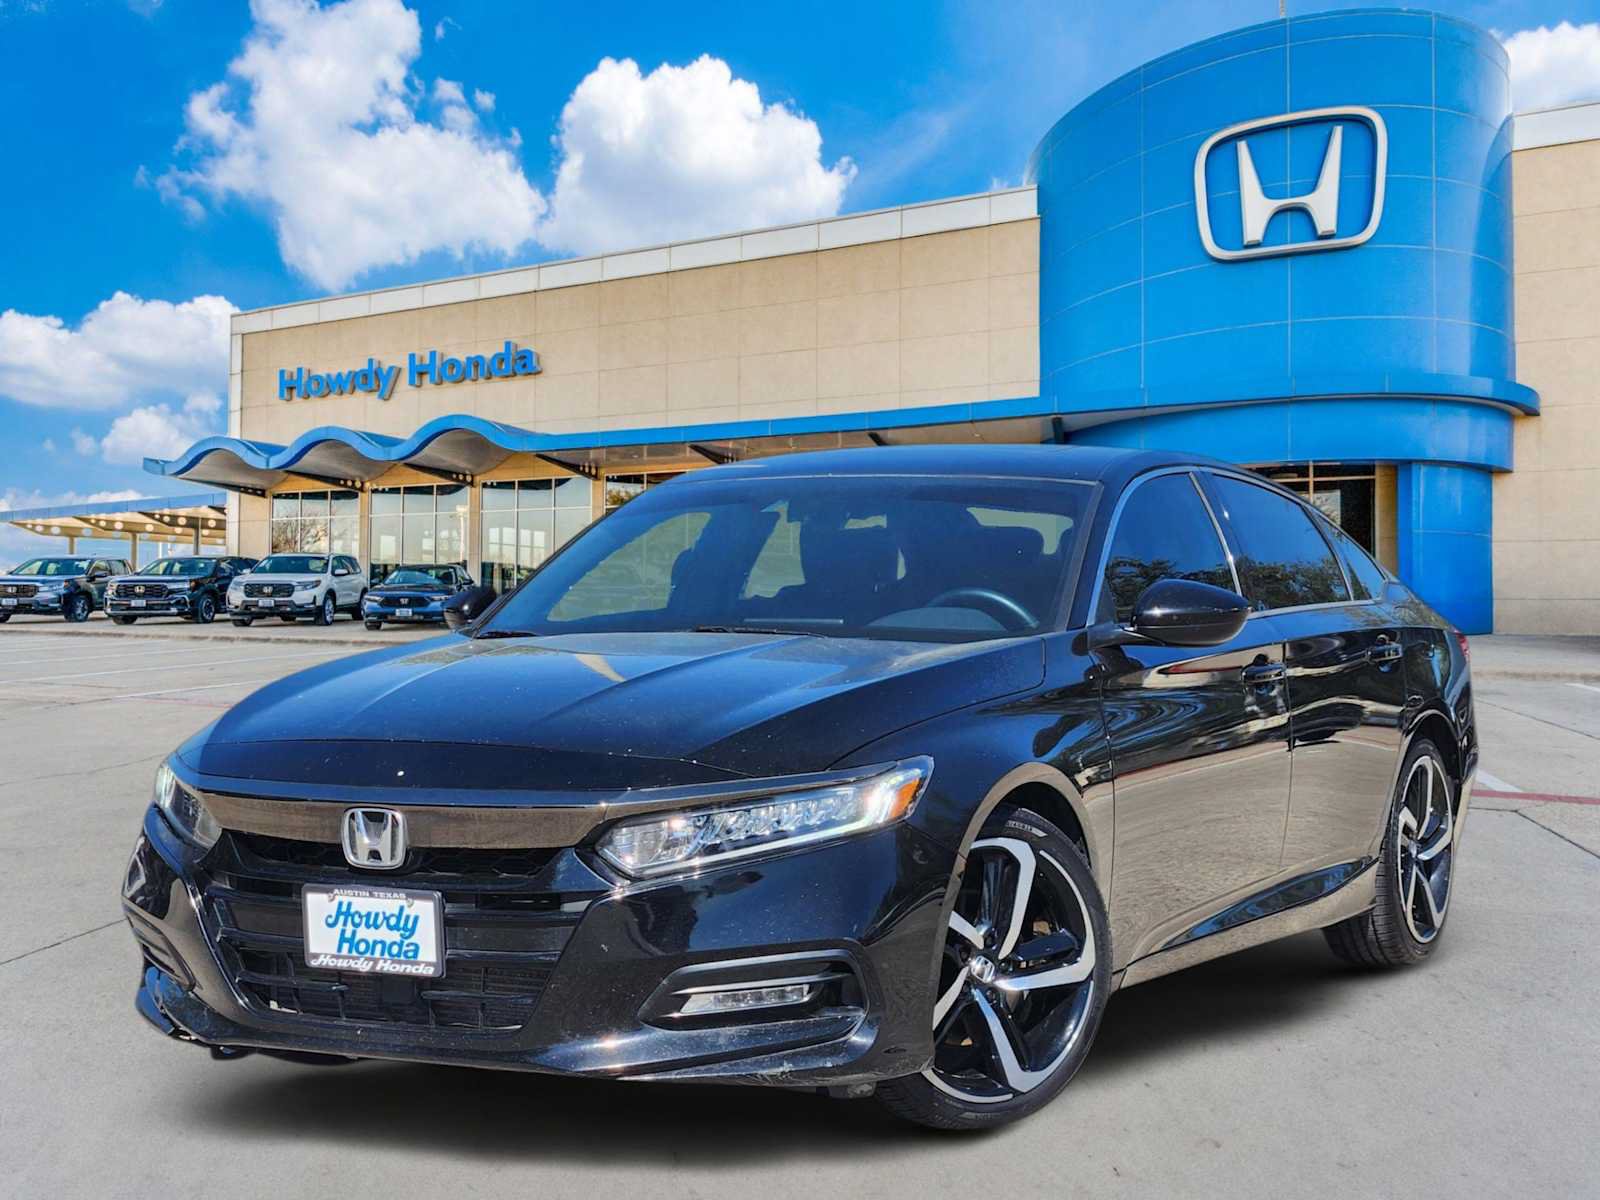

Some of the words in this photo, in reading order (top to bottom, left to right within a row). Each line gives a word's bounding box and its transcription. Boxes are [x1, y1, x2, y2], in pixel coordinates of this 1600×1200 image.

[278, 358, 400, 401] Howdy
[408, 340, 541, 387] Honda
[333, 888, 370, 897] AUSTIN
[373, 891, 406, 899] TEXAS
[325, 900, 419, 940] Howdy
[337, 929, 420, 960] Honda
[311, 955, 373, 972] Howdy
[376, 959, 435, 975] Honda
